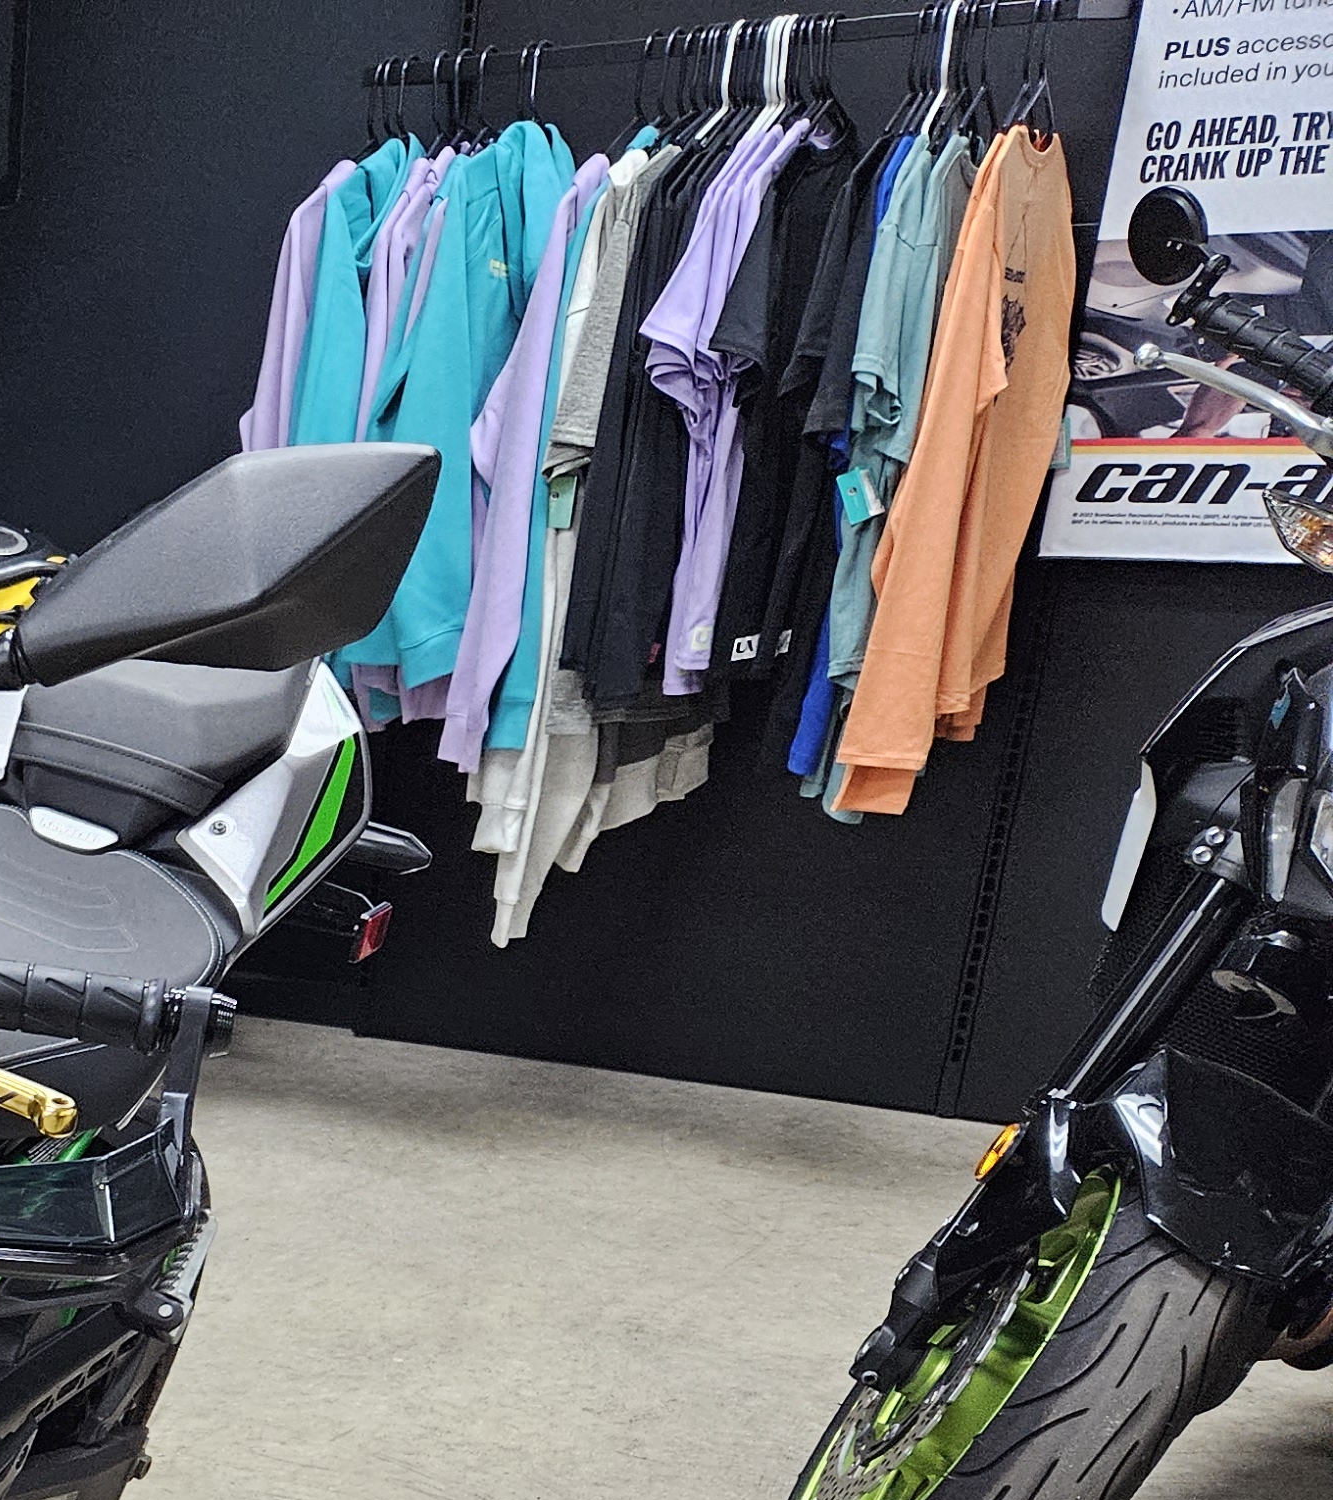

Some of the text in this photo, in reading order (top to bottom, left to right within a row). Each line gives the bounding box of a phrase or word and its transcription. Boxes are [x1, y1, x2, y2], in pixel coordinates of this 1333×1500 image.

[1164, 37, 1231, 61] PLUS
[1158, 62, 1333, 89] included in you
[1146, 120, 1181, 152] GO
[1188, 114, 1281, 149] AHEAD,
[1140, 144, 1331, 184] CRANK UP THE
[1075, 463, 1333, 509] can-a
